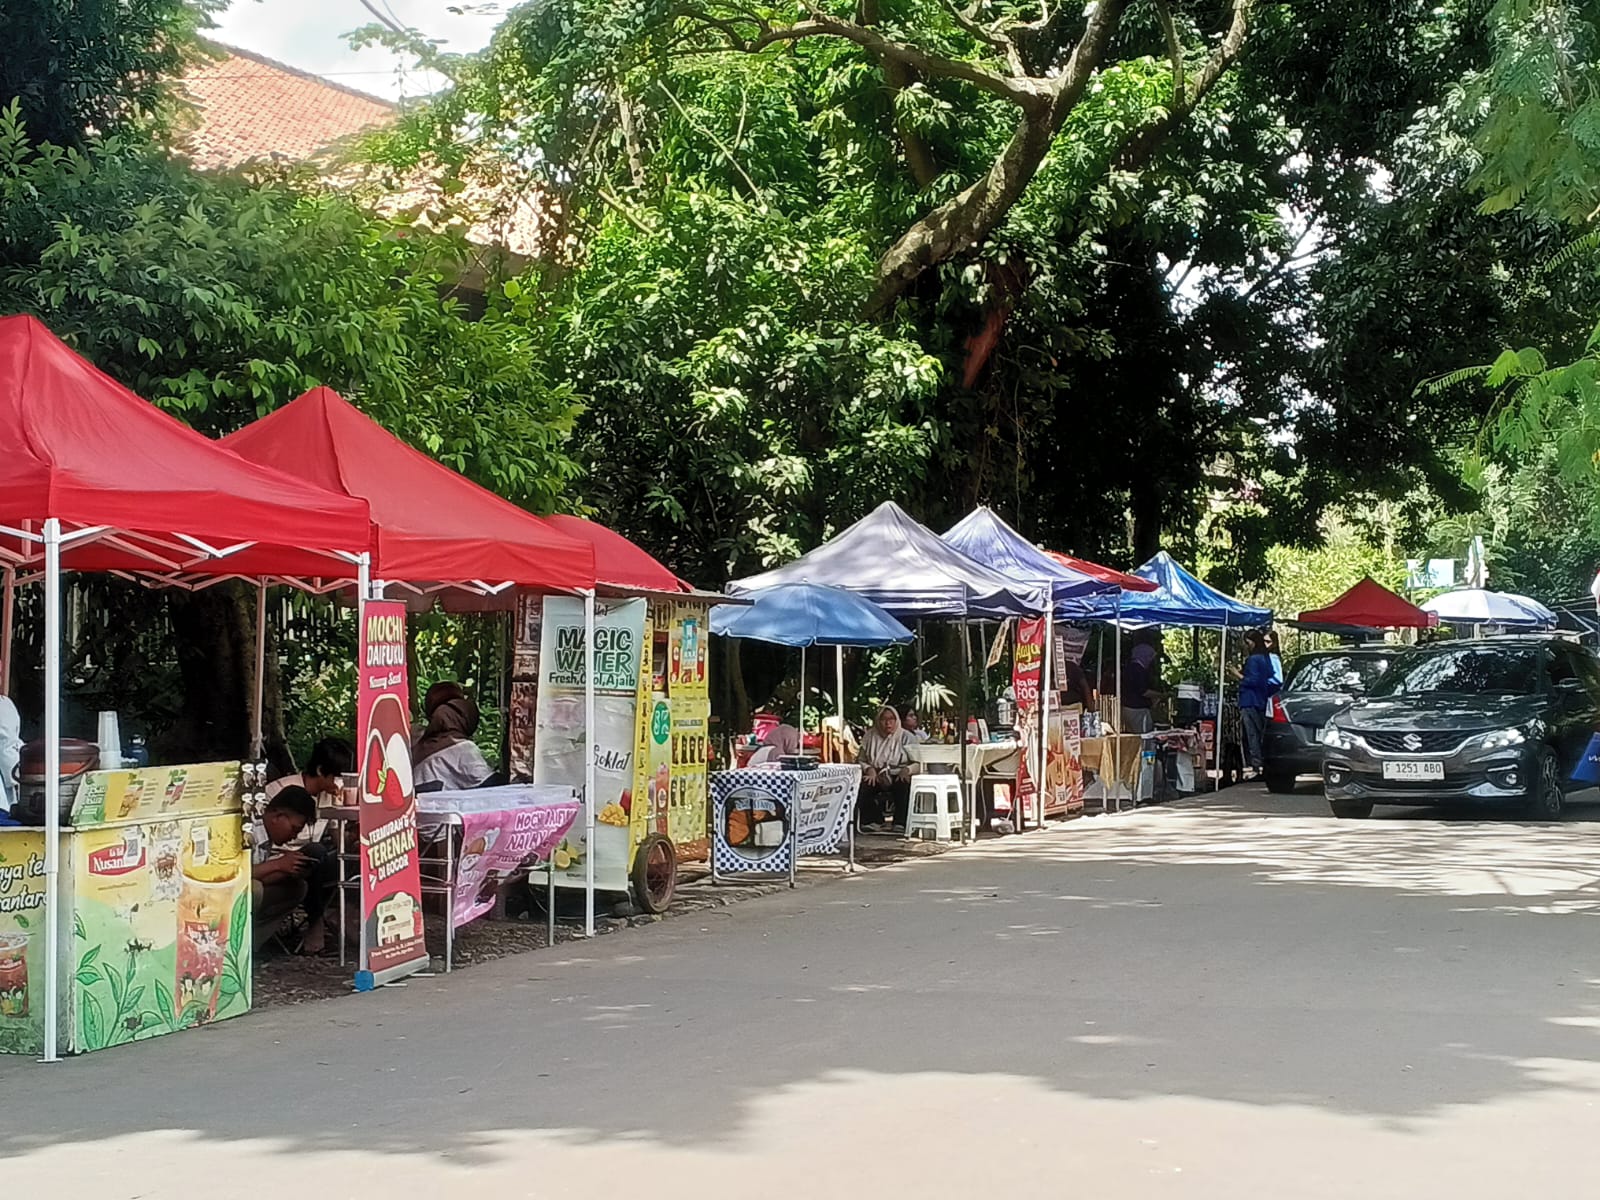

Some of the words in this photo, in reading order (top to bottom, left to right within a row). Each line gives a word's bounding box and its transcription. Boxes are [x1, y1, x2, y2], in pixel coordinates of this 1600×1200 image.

[367, 615, 403, 644] MOCHI
[367, 645, 404, 667] DAIFUKU
[1396, 763, 1418, 773] 1251
[367, 828, 415, 870] TERENAK
[93, 857, 124, 872] Nusan
